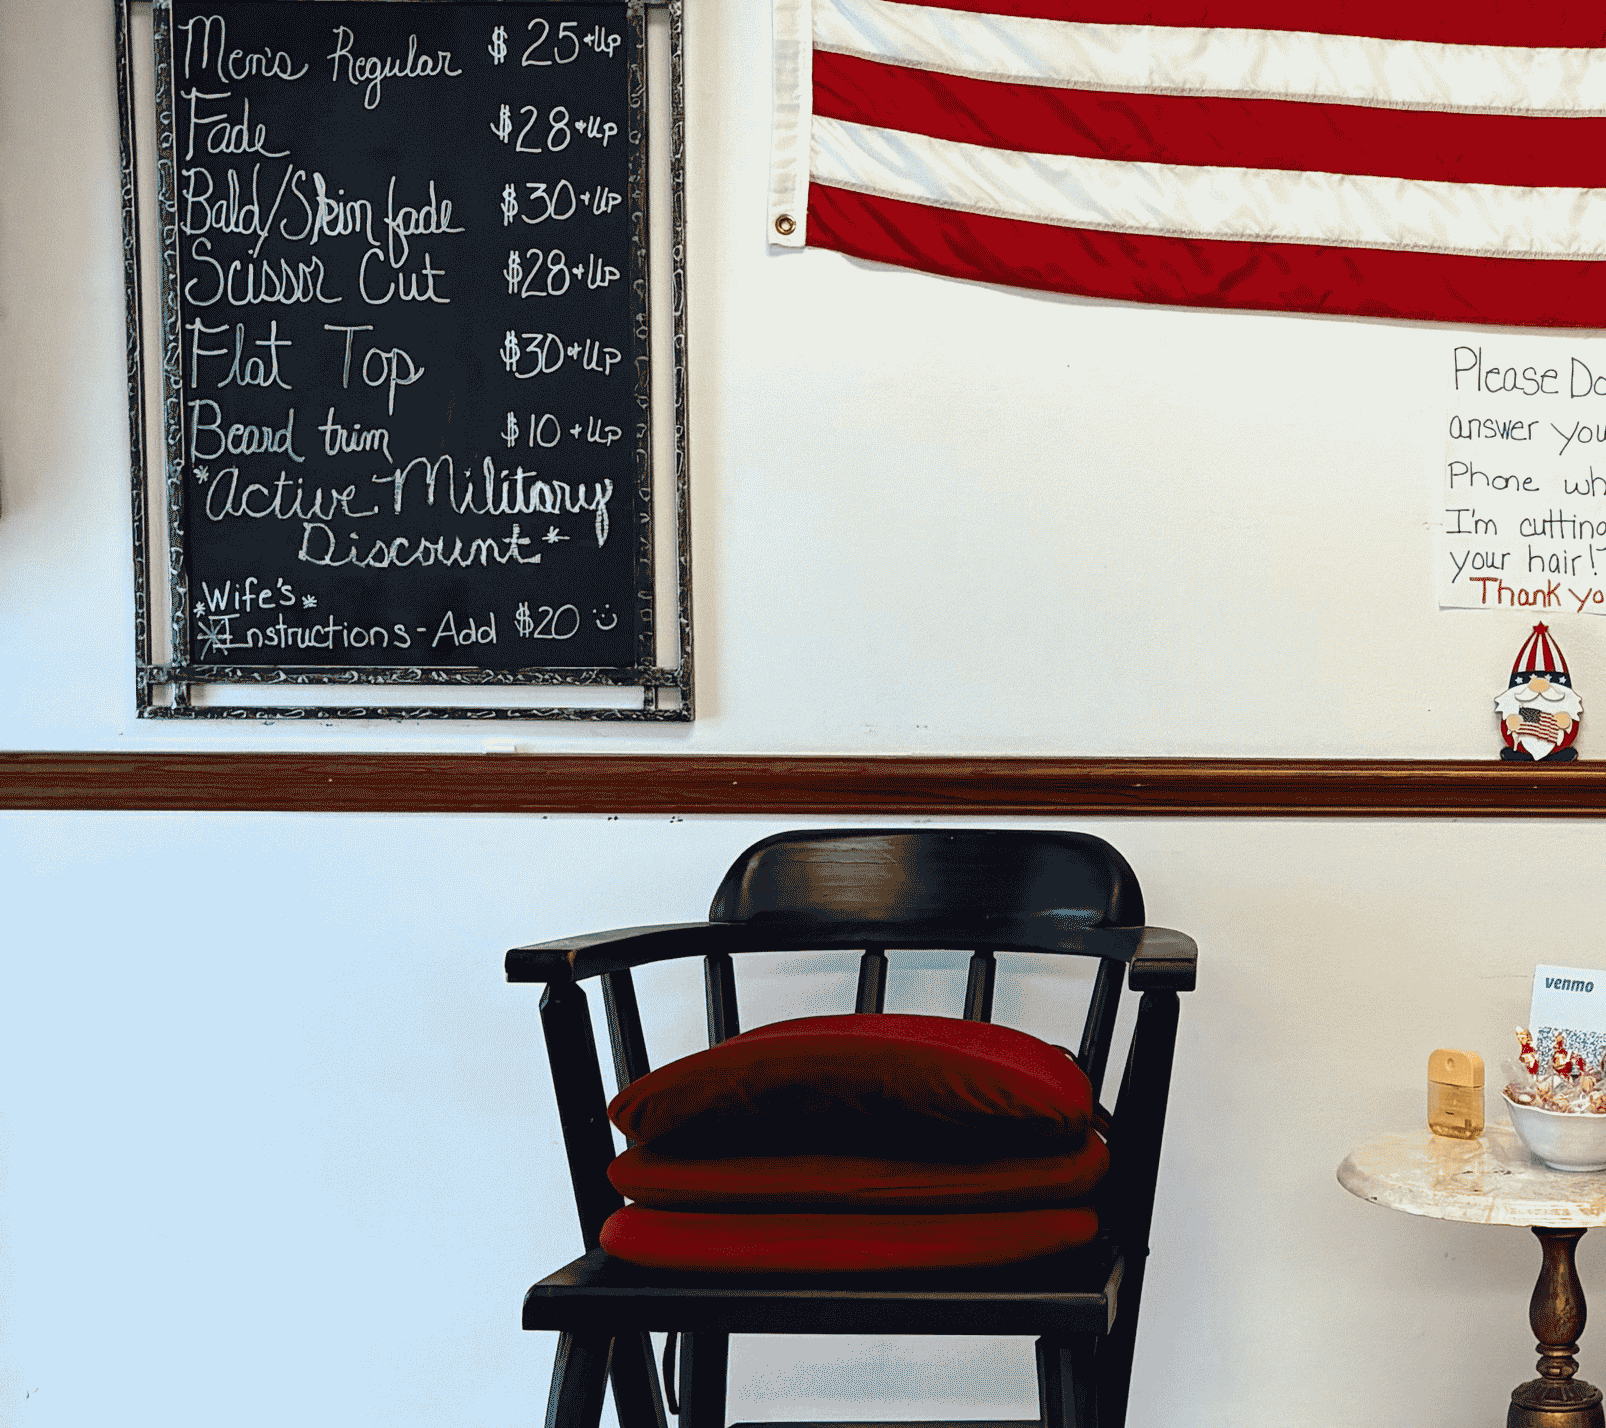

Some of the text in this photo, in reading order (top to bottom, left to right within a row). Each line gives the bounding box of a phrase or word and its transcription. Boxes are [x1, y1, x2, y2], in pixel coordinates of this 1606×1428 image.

[178, 15, 309, 83] Men's
[326, 25, 463, 110] Regular
[180, 86, 291, 161] Fade
[360, 247, 450, 304] Cut
[187, 318, 291, 391] Flat
[324, 324, 424, 416] Top
[1454, 346, 1559, 396] Please
[188, 400, 305, 462] Beard
[318, 407, 394, 464] trim
[1449, 415, 1540, 441] answer
[1447, 461, 1540, 492] Phone
[371, 454, 613, 548] Military
[1445, 508, 1498, 536] I'm
[1449, 543, 1598, 584] your hair!
[1469, 576, 1561, 608] Thank
[432, 611, 497, 648] Add
[515, 602, 580, 640] $20
[1545, 977, 1595, 994] venmo
